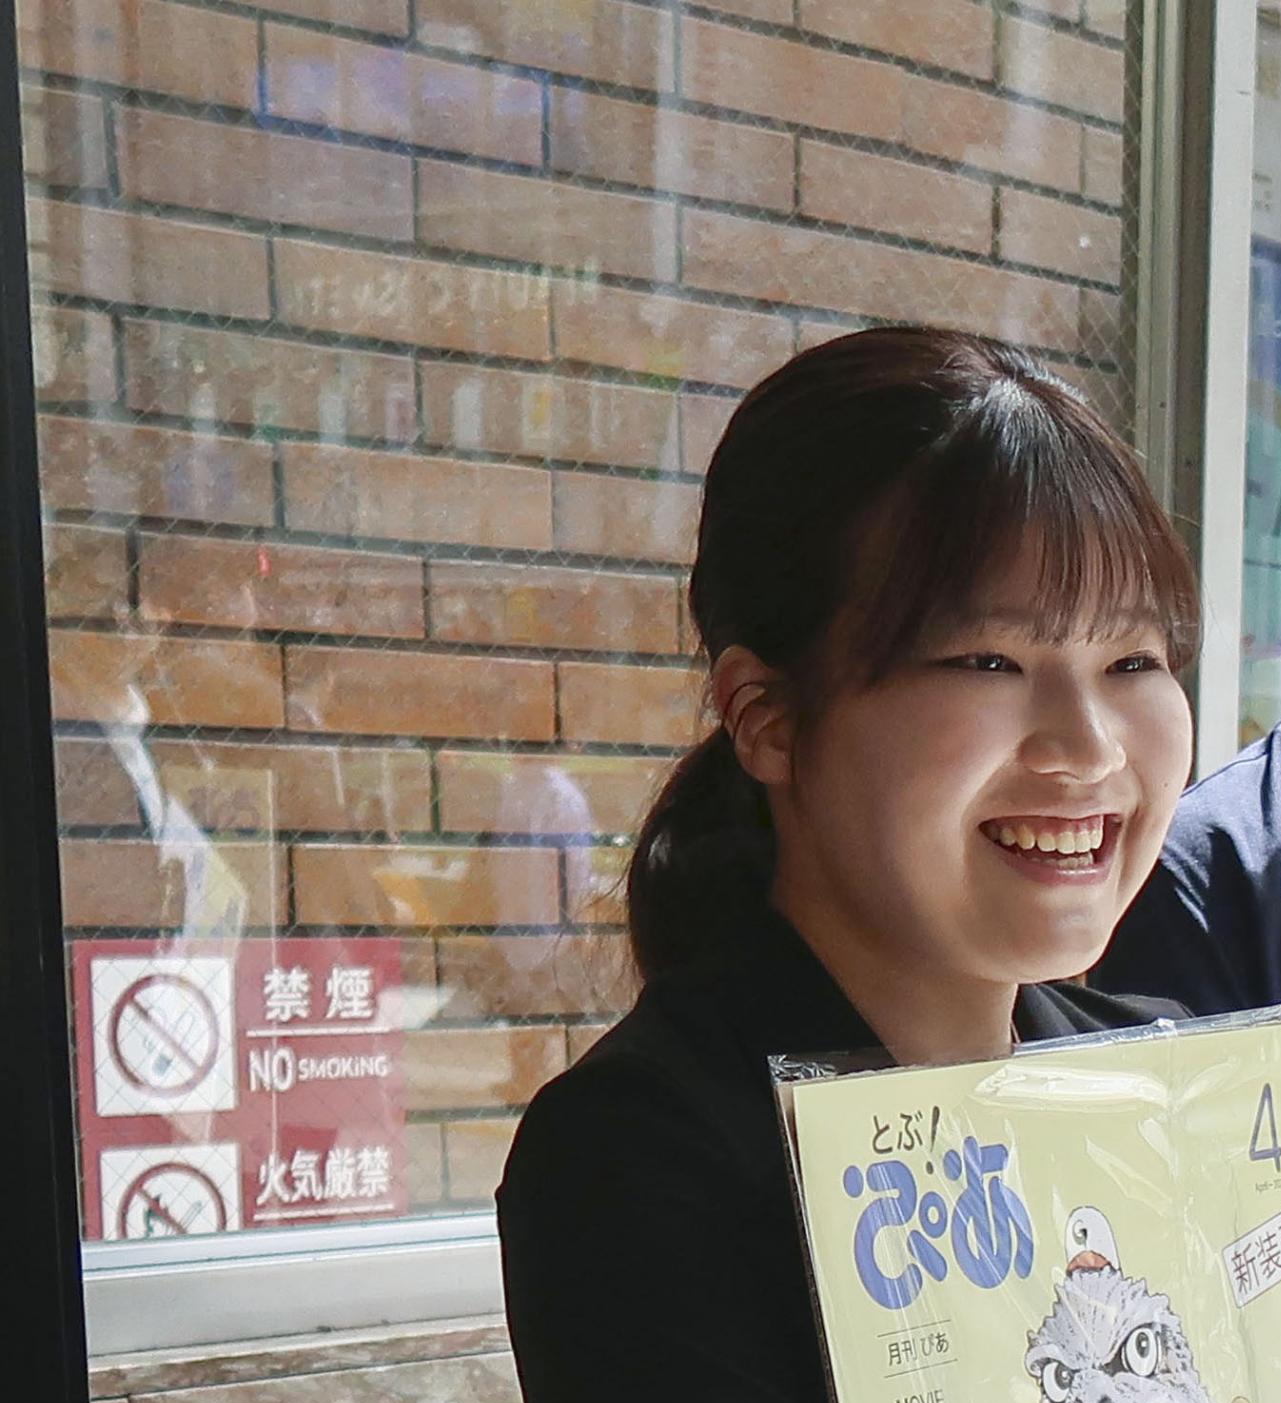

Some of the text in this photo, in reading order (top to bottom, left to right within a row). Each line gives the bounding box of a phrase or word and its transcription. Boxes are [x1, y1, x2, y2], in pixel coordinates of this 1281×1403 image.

[263, 966, 375, 1023] 禁煙
[249, 1048, 296, 1093] NO
[255, 1146, 393, 1205] 火気厳禁
[842, 1135, 1035, 1311] ぴあ
